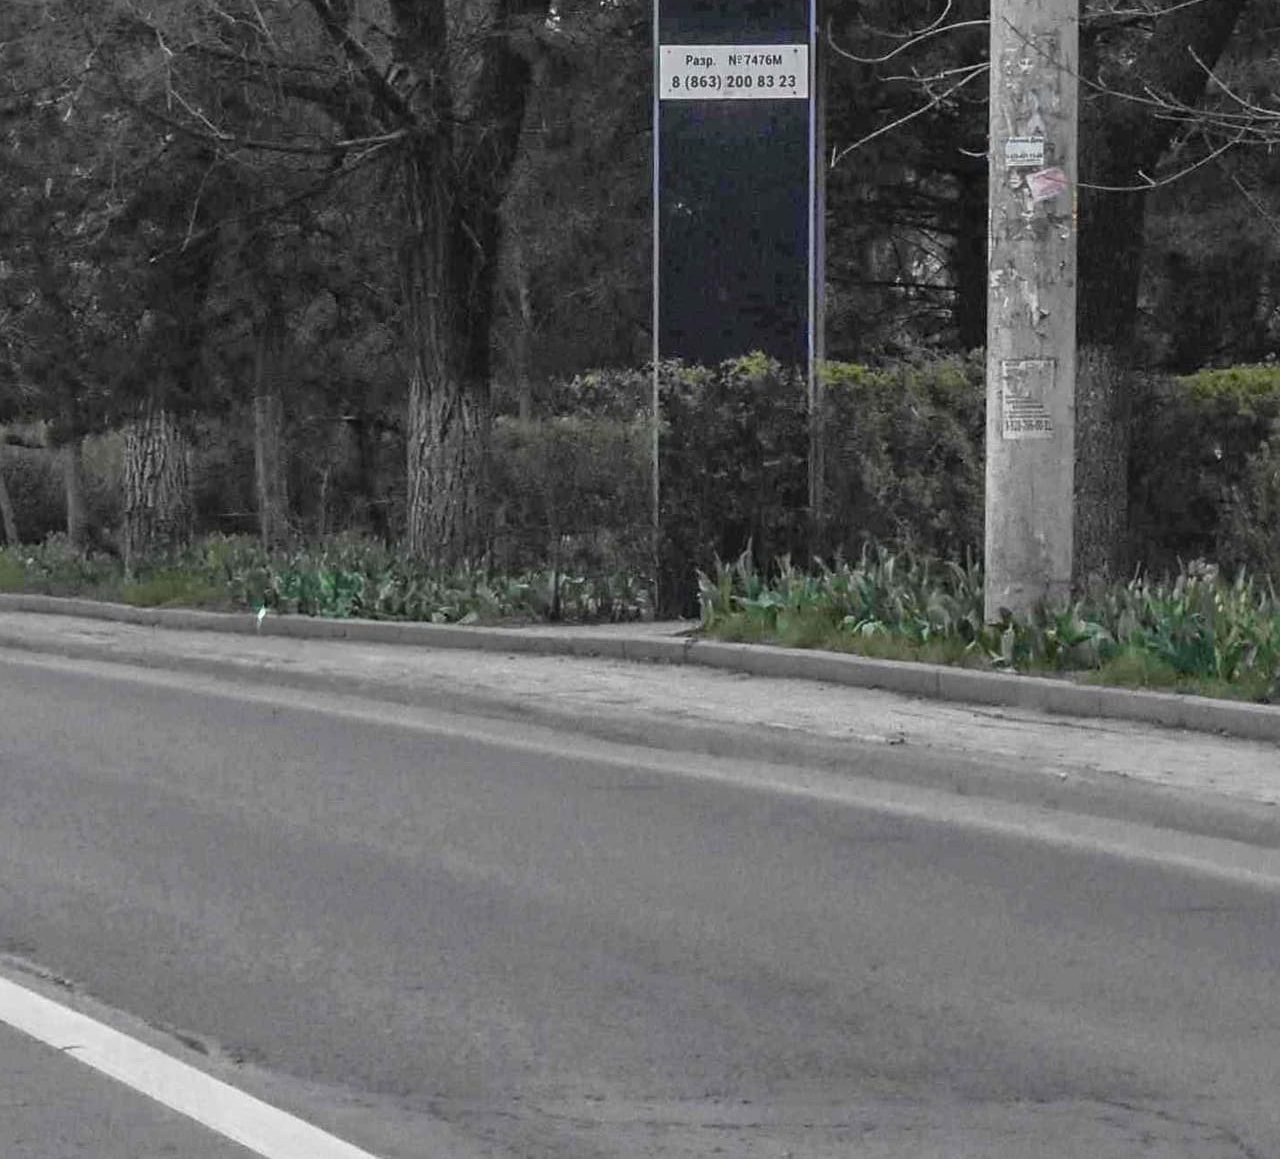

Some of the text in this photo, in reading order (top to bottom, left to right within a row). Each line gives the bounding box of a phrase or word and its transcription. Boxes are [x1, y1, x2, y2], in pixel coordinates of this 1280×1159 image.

[685, 54, 717, 68] Разр.
[671, 75, 797, 91] 8 (863) 200 83 23
